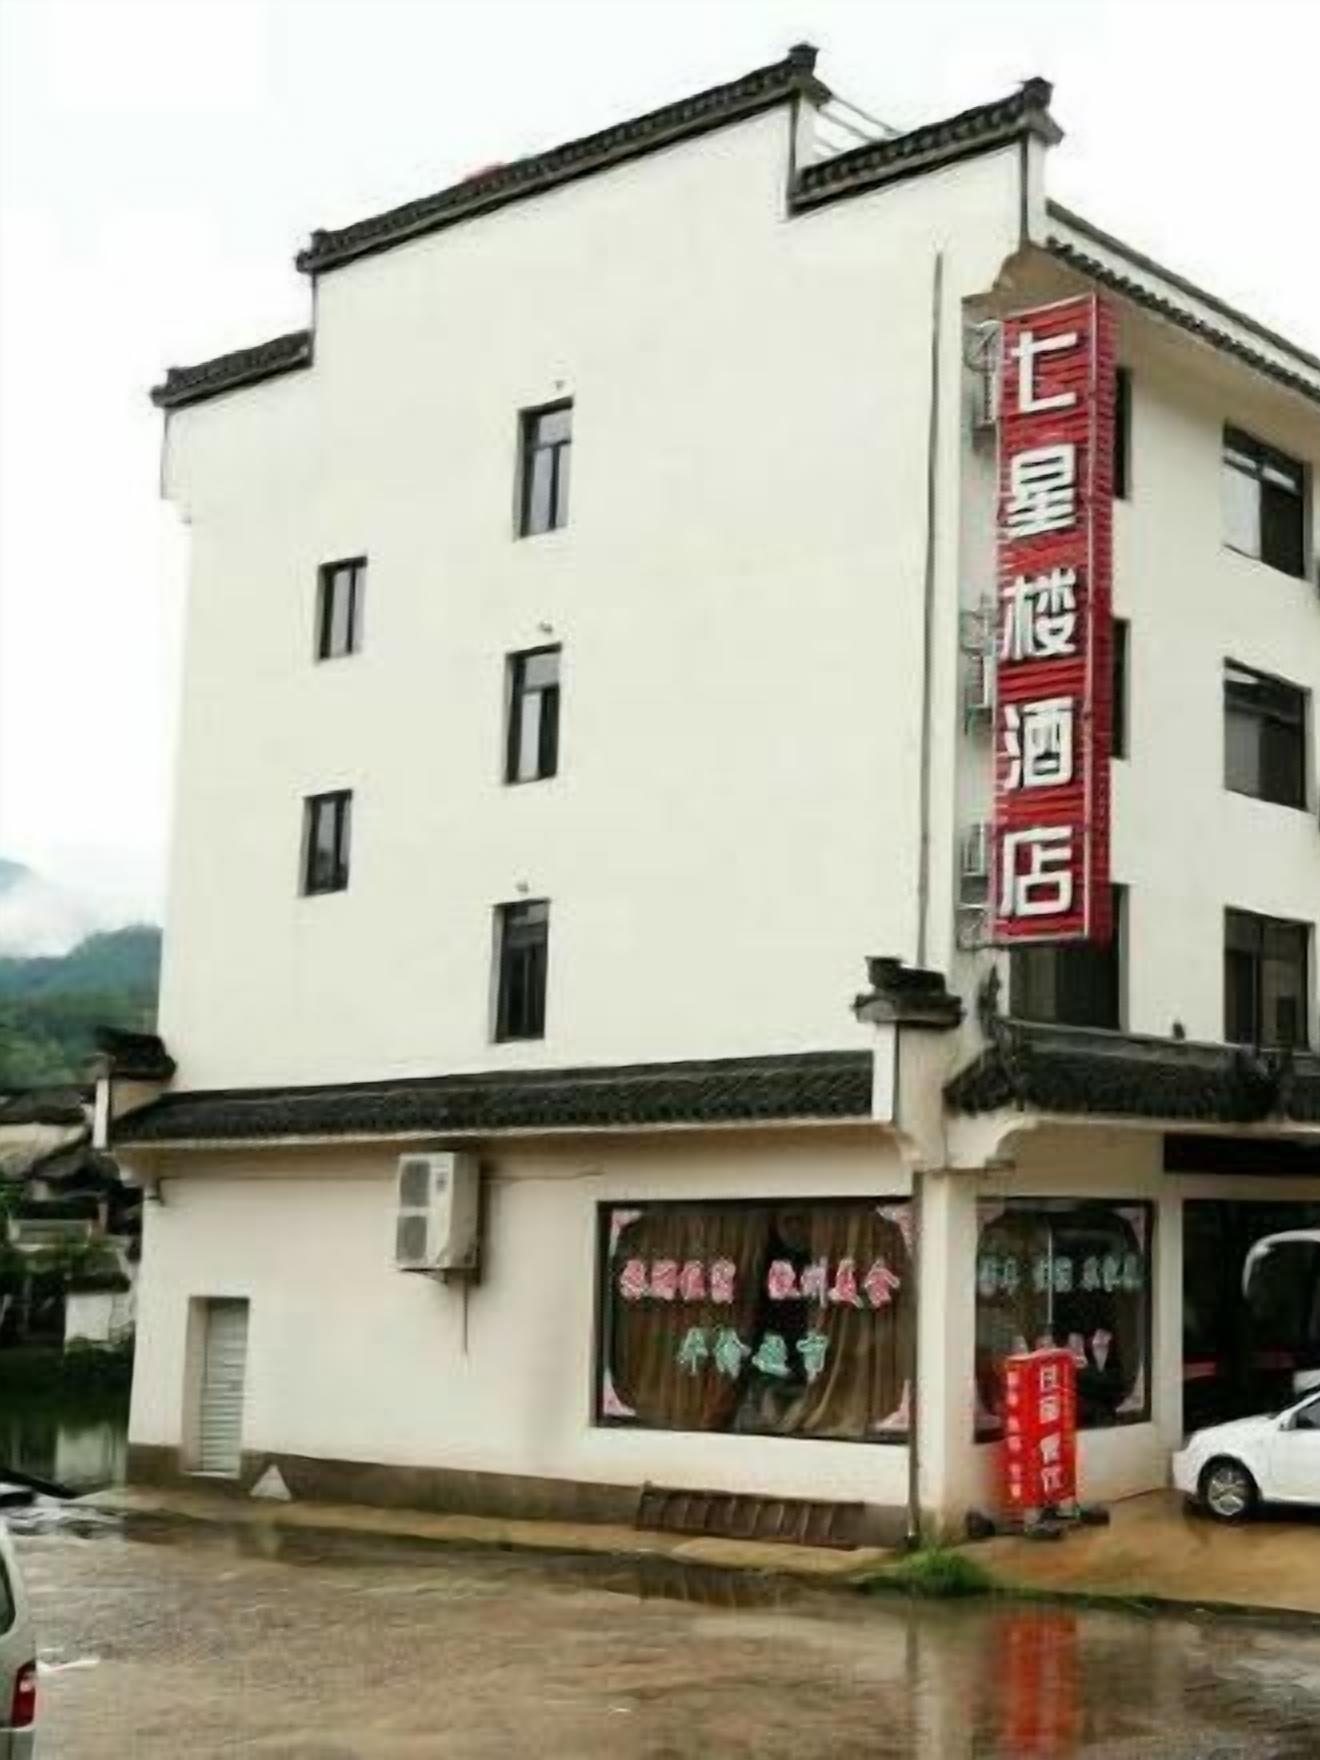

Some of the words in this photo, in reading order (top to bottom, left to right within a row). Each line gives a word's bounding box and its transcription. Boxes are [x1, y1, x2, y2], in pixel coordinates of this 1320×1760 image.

[999, 329, 1079, 916] 七星楼酒店
